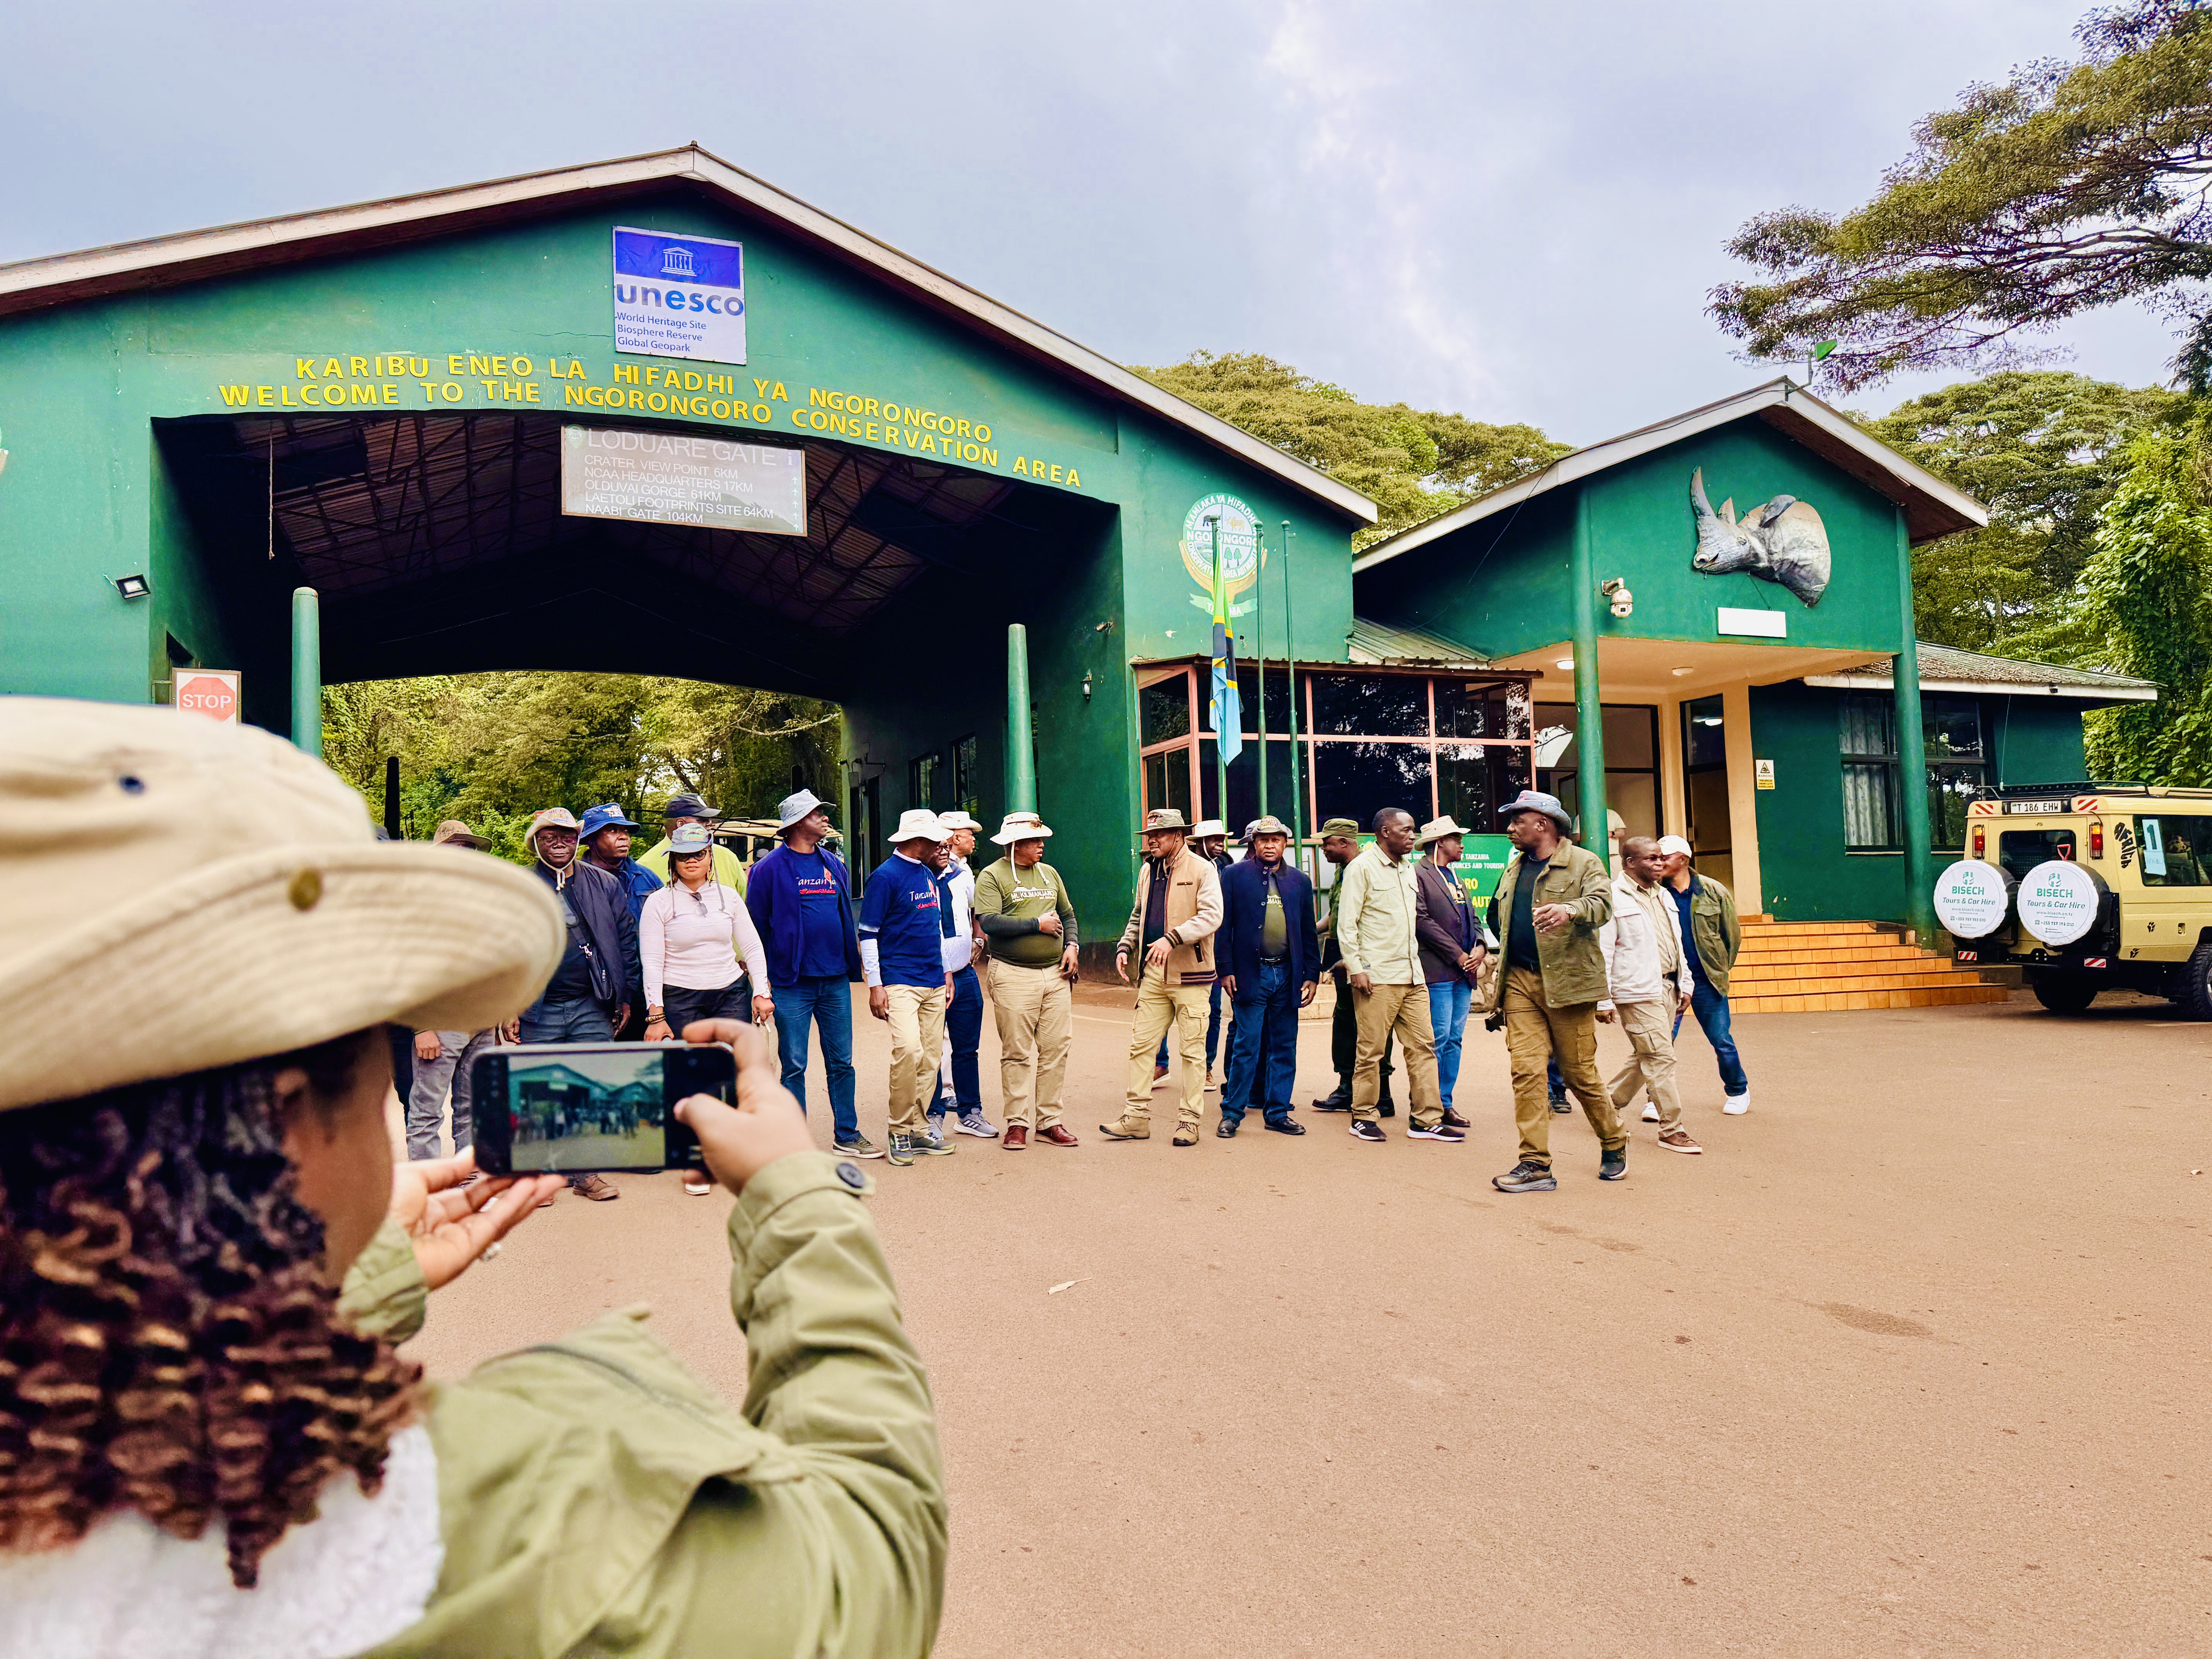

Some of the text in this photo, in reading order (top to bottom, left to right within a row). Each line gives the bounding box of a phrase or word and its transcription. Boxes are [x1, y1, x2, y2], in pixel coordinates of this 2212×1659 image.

[617, 284, 744, 316] unesco
[617, 312, 706, 329] World Heritage Site
[618, 325, 702, 341] Biosphere Reserve
[618, 337, 690, 352] Global Geopark
[296, 355, 992, 443] KARIBU ENEO LA HIFADHI YA NGORONGORO
[219, 380, 1081, 488] WELCOME TO THE NGORONGORO CONSERVATION AREA
[588, 428, 707, 459] LODUARE
[713, 441, 776, 466] GATE
[584, 455, 738, 479] CRATER VIEW POINT 6KM
[585, 467, 753, 493] NCAA HEADQUARTERS 17KM
[585, 479, 721, 501] OLDUVAI GORGE 61KM
[586, 491, 773, 519] LAETOLI FOOTPRINTS SITE 64KM
[586, 504, 703, 524] NAABI GATE 104KM
[1185, 495, 1257, 530] MAMLAKA YA HIFADHI
[1187, 530, 1257, 547] NGONGORO
[182, 694, 232, 709] STOP
[2017, 802, 2058, 812] T 186 EHW
[2114, 822, 2137, 869] AFRICA
[2147, 824, 2157, 850] 1
[796, 877, 836, 886] anzana
[1952, 886, 1984, 895] BISECH
[2037, 888, 2073, 898] BISECH
